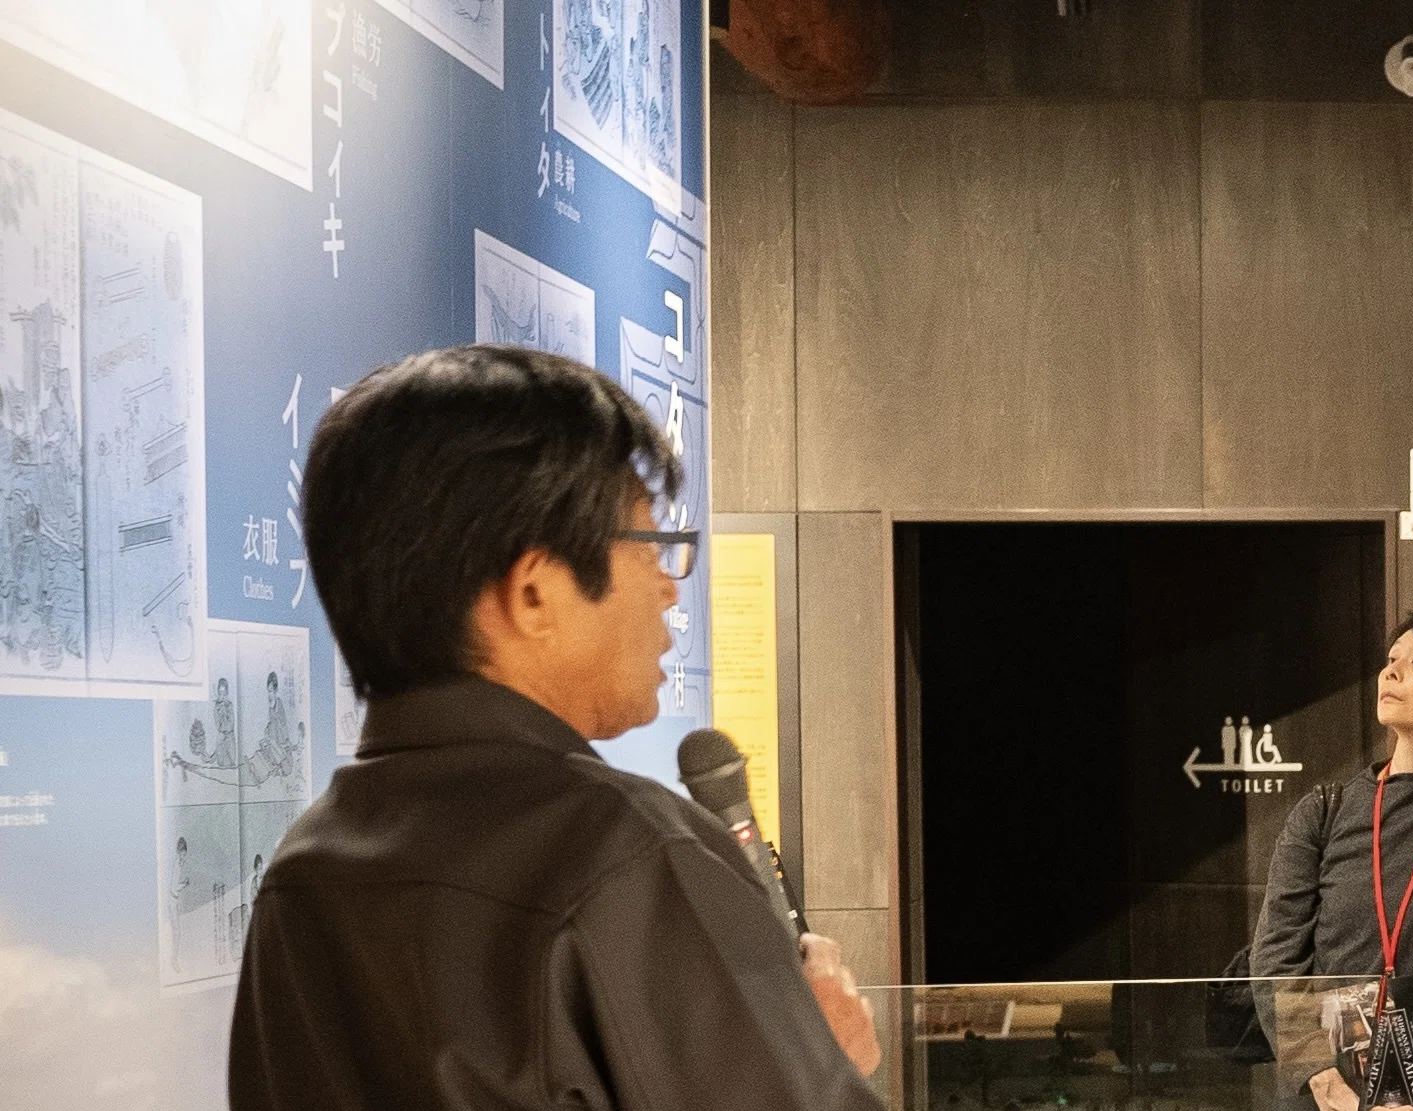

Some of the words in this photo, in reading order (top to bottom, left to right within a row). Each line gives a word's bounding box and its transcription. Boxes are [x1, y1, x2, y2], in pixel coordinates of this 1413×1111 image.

[537, 12, 551, 199] トイタ
[243, 514, 279, 566] 衣服
[243, 575, 274, 601] Clothes
[1221, 778, 1285, 793] TOILET
